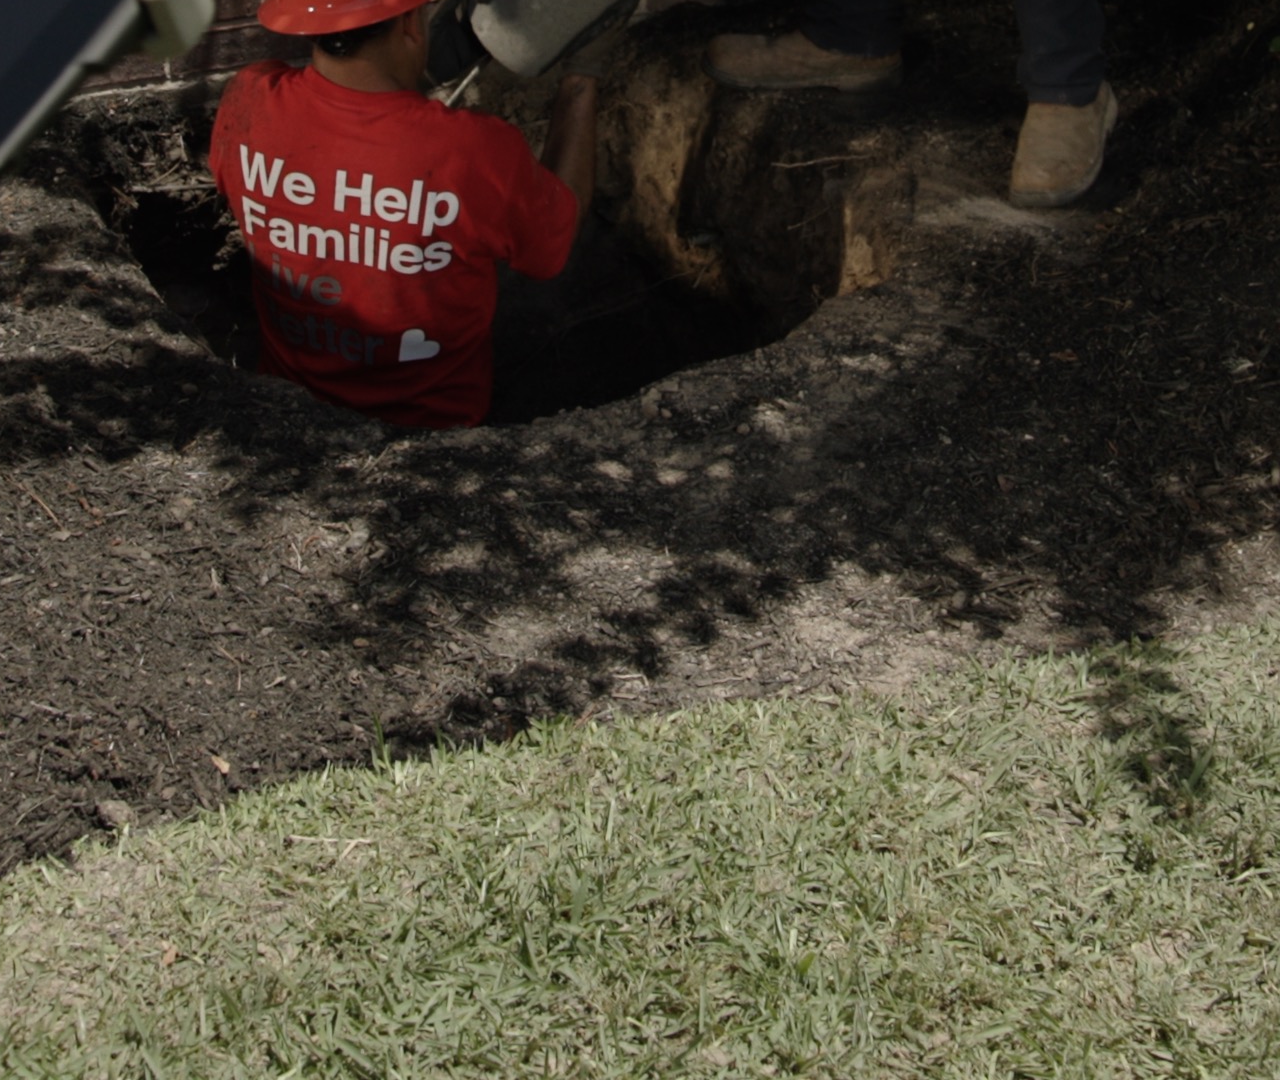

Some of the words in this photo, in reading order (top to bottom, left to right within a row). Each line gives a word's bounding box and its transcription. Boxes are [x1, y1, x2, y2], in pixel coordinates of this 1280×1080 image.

[239, 144, 316, 206] We
[333, 169, 460, 237] Help
[241, 195, 453, 275] Families
